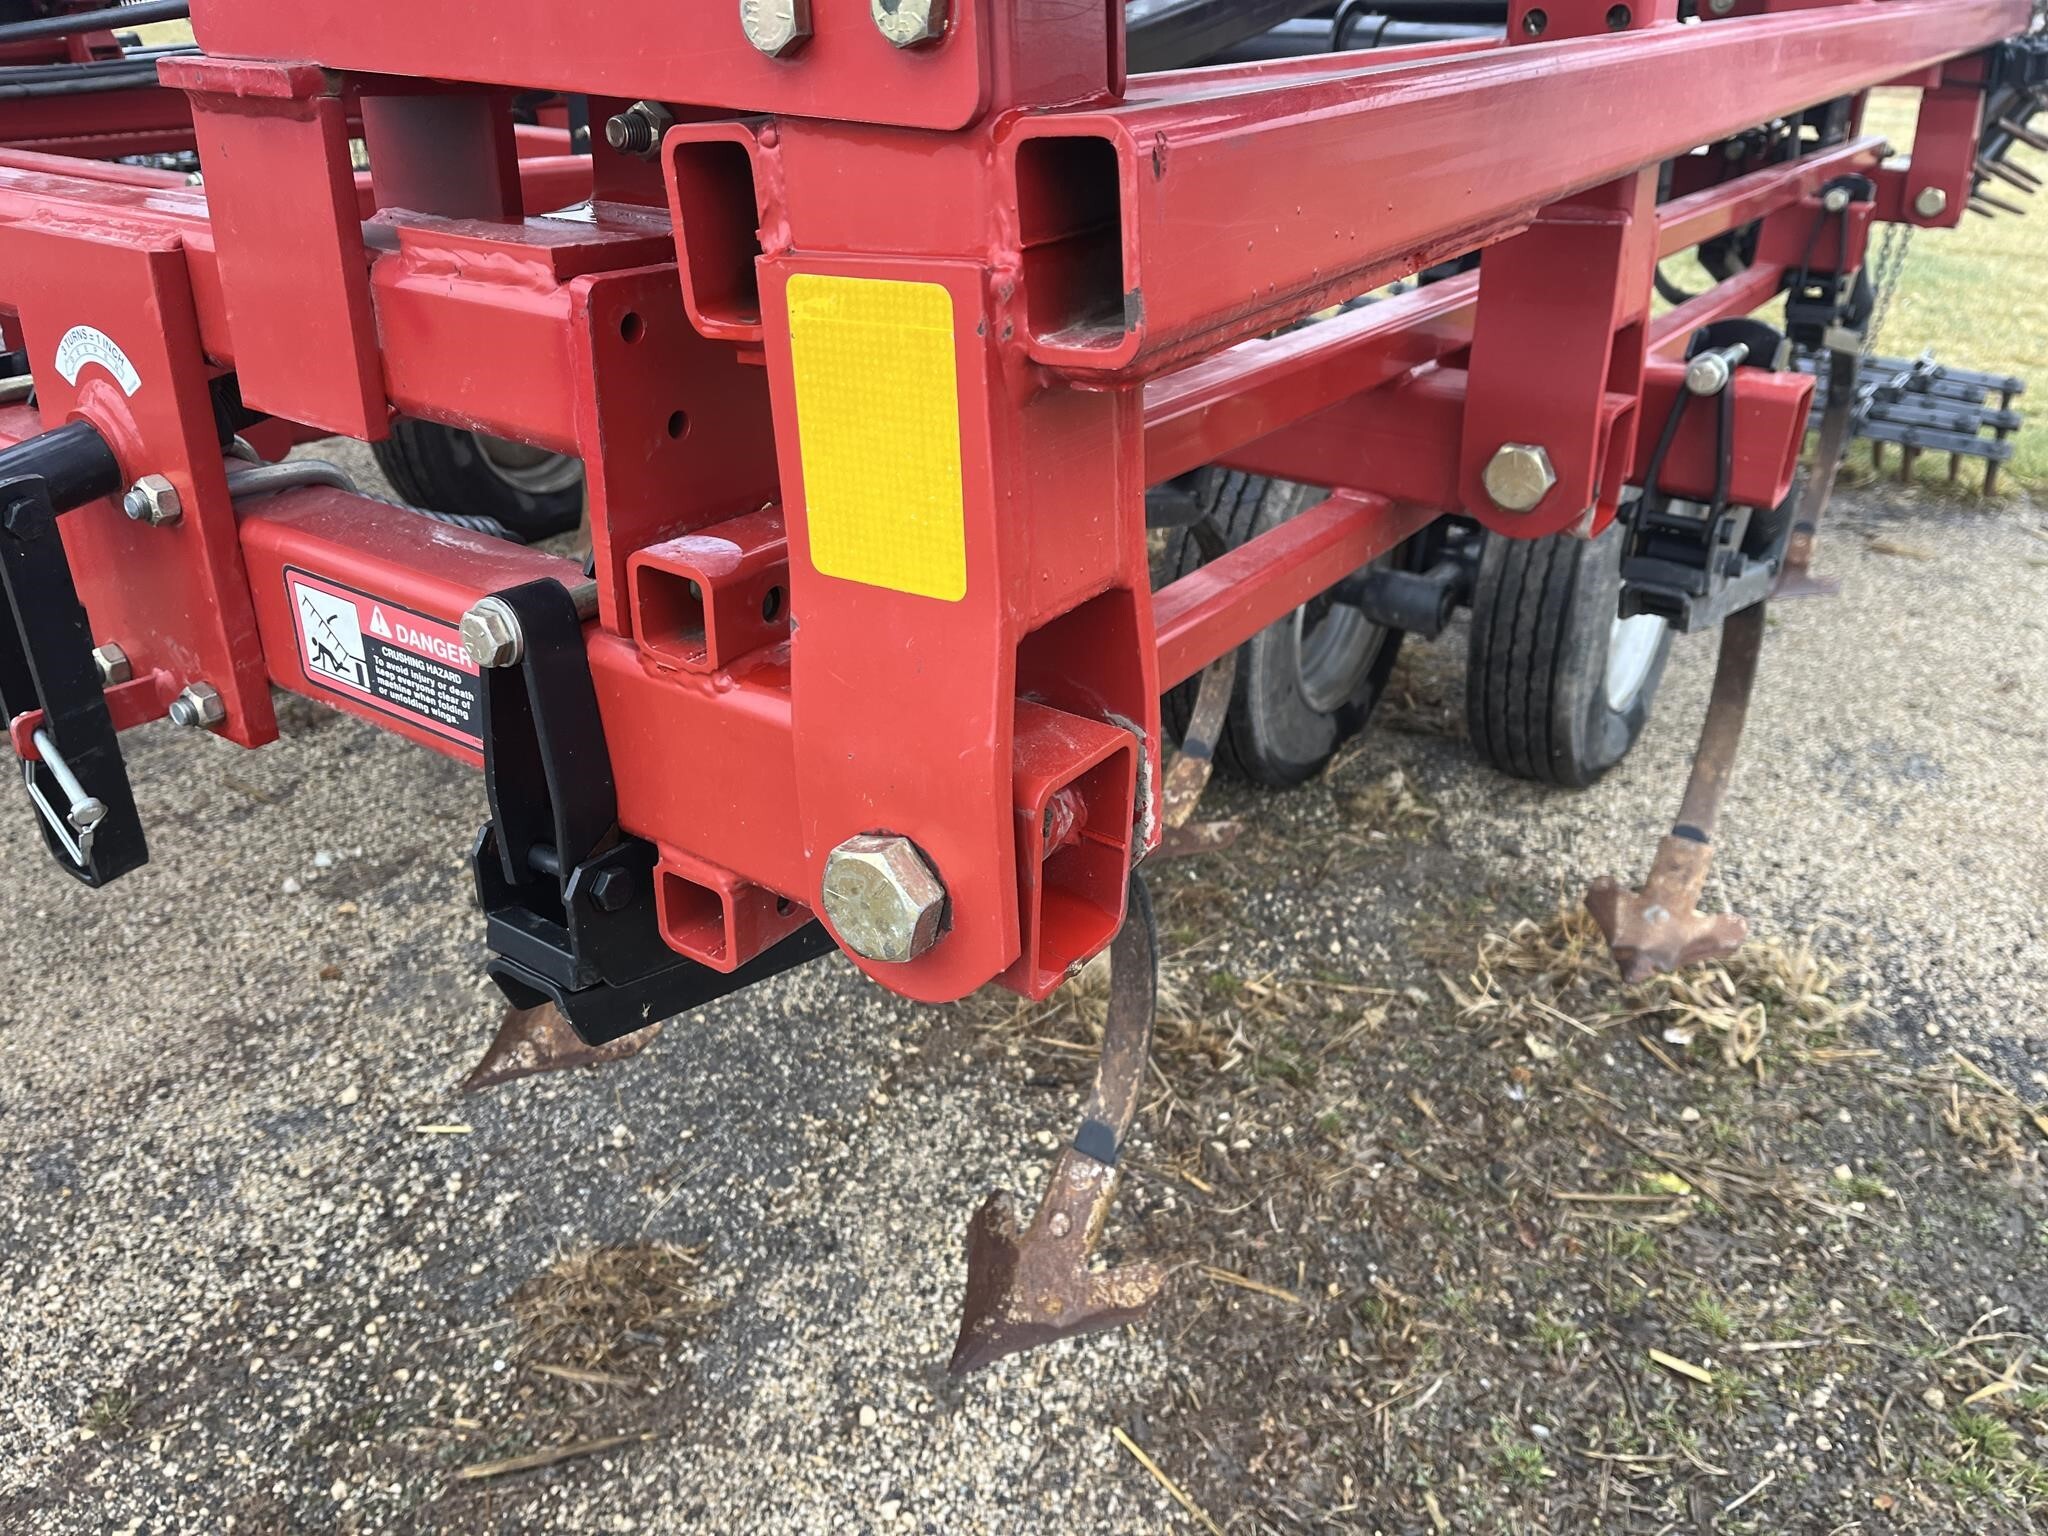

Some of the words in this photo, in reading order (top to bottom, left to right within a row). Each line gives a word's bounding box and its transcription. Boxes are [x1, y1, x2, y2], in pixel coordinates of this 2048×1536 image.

[64, 328, 88, 348] TURNS
[96, 334, 101, 345] 1
[102, 338, 124, 366] INCH
[381, 646, 425, 671] CRUSHING
[426, 662, 462, 685] HAZARD
[395, 623, 473, 668] DANGER
[373, 654, 384, 667] To
[386, 661, 409, 676] avoid
[410, 669, 435, 688] injury
[437, 681, 447, 691] or
[449, 685, 474, 702] death
[375, 665, 396, 681] keep
[397, 675, 436, 696] everyone
[437, 691, 459, 705] clear
[461, 700, 471, 710] of
[377, 676, 412, 696] machine
[413, 690, 436, 706] when
[437, 699, 469, 720] folding
[378, 686, 388, 695] or
[389, 690, 429, 714] unfolding
[431, 707, 459, 725] wings.
